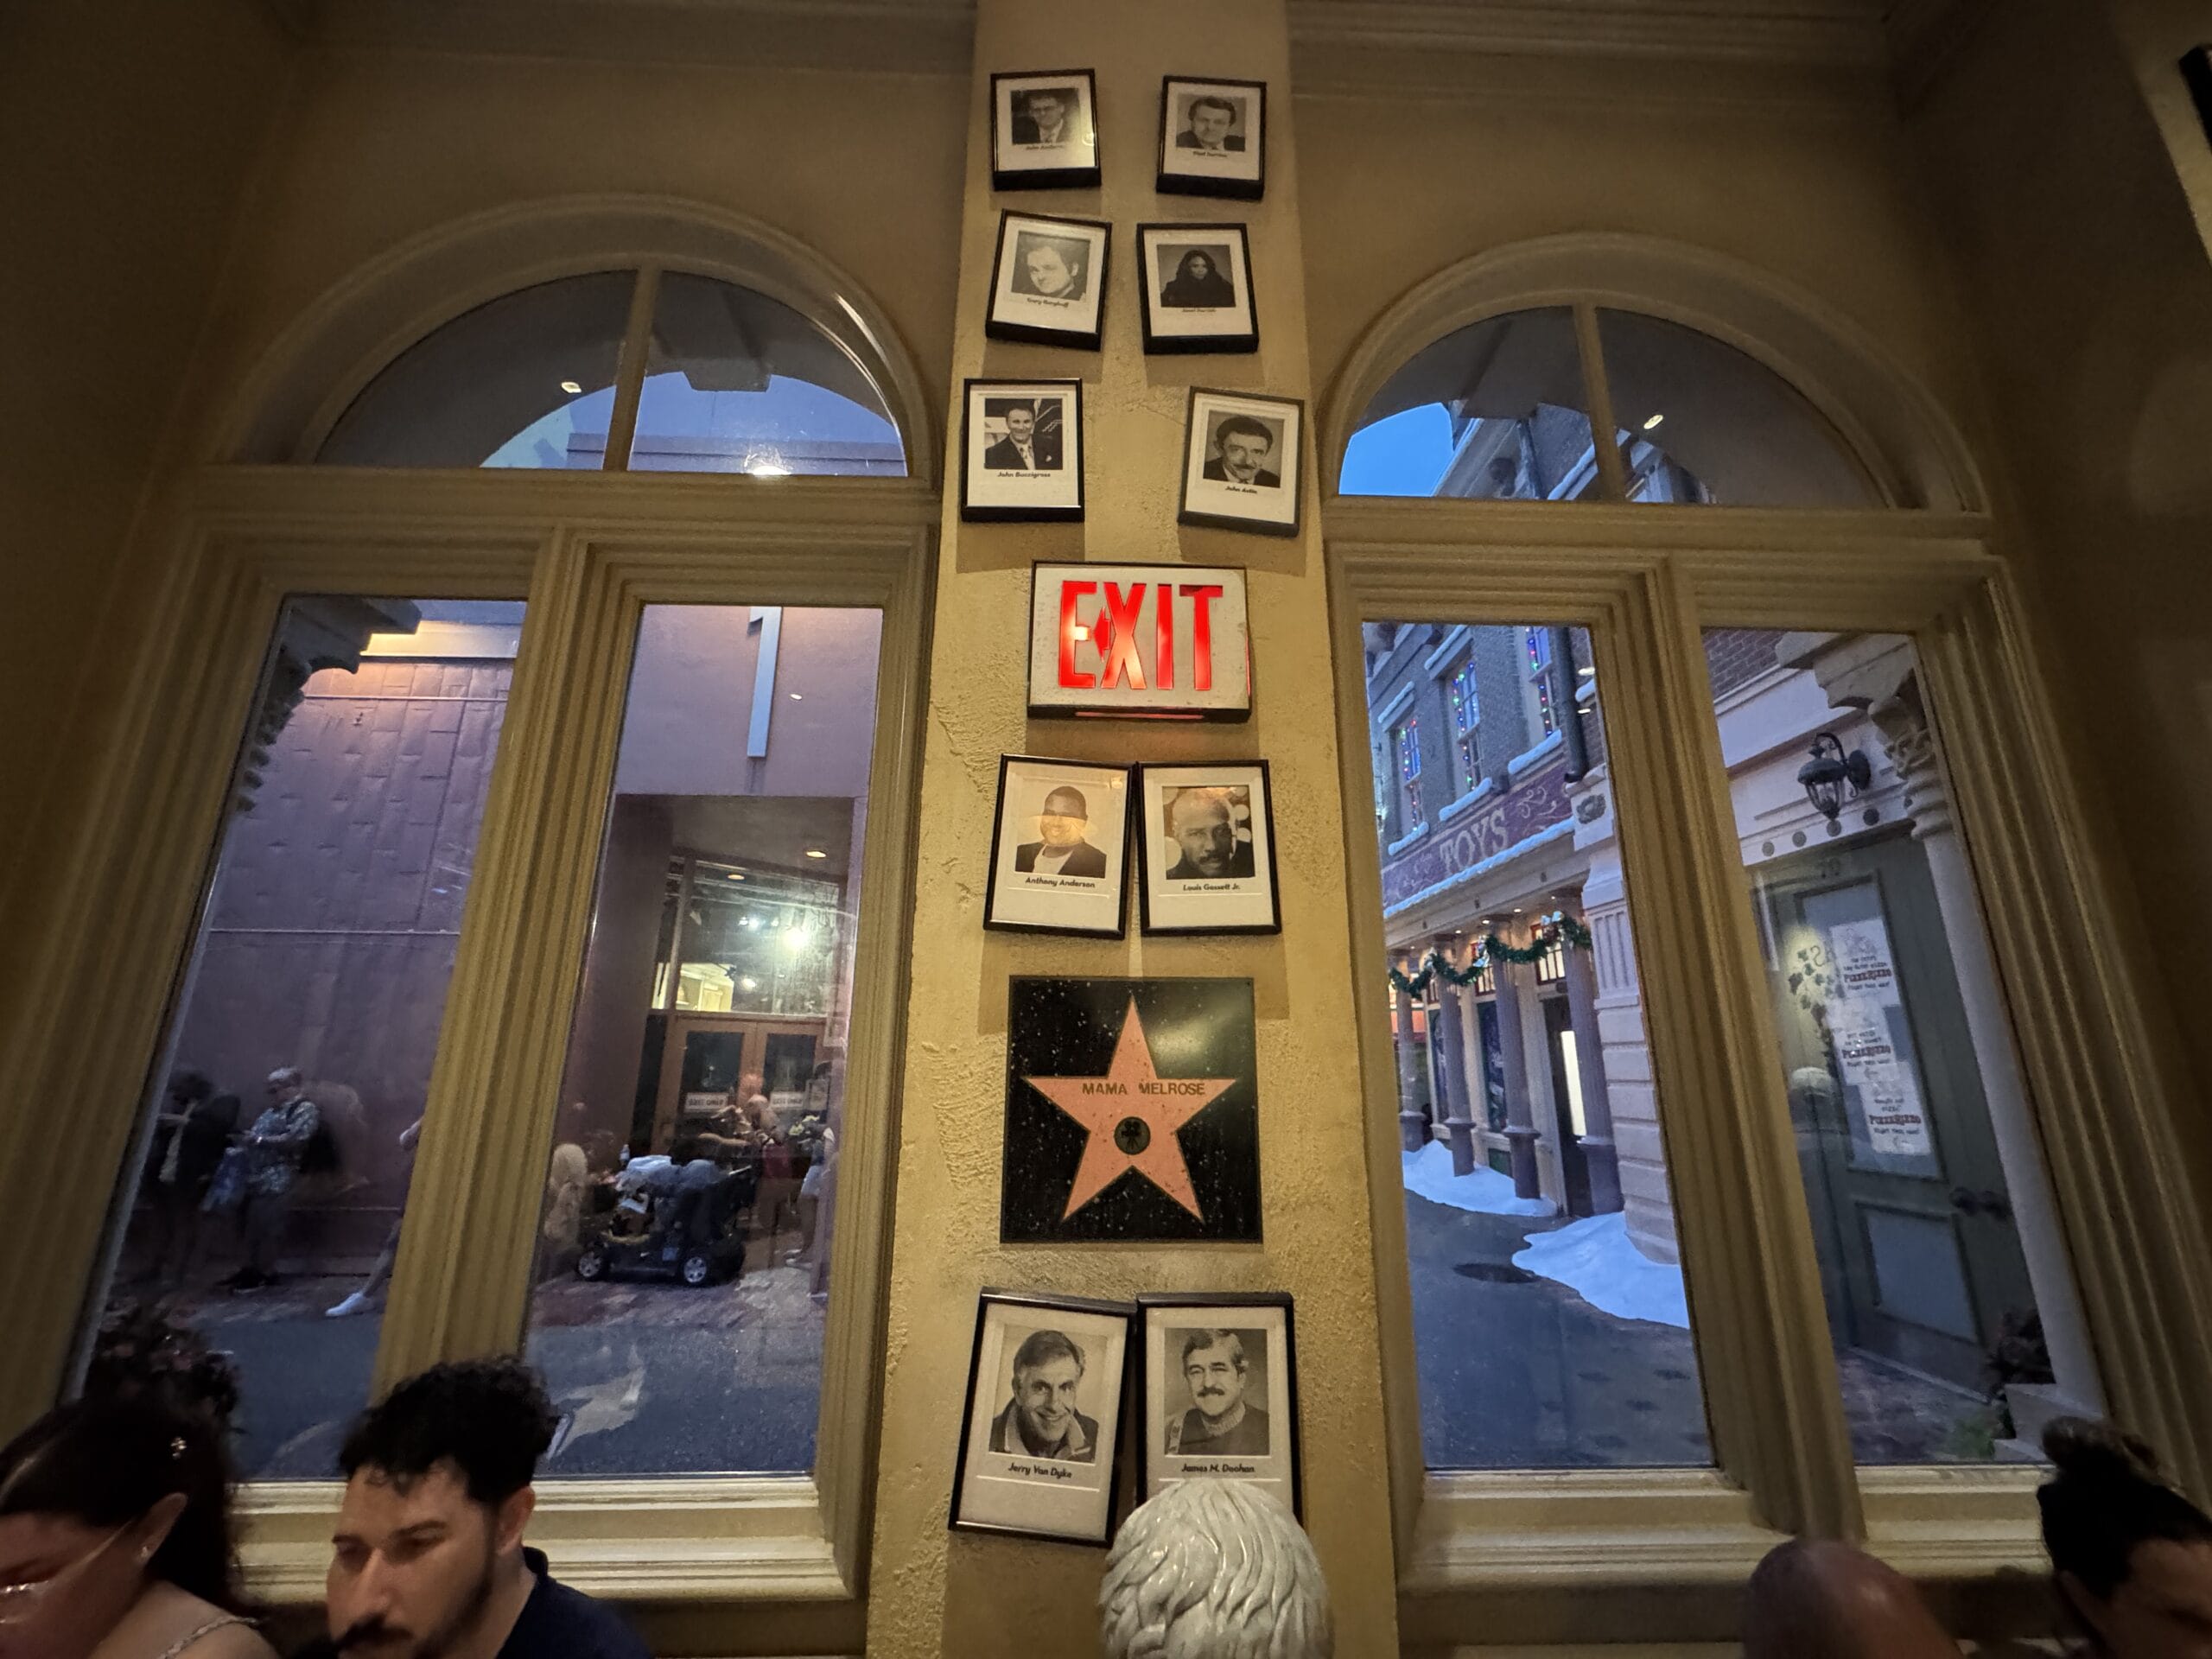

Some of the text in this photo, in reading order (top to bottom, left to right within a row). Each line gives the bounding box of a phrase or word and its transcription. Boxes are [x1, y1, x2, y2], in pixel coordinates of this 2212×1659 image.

[1058, 580, 1224, 690] EXIT
[1440, 808, 1508, 876] TOYS
[1026, 876, 1058, 887] Anthony
[1082, 1083, 1205, 1096] MAMA MELROSE
[1008, 1463, 1072, 1479] Jerry Van Dyke
[1182, 1463, 1255, 1472] James M. Doohan
